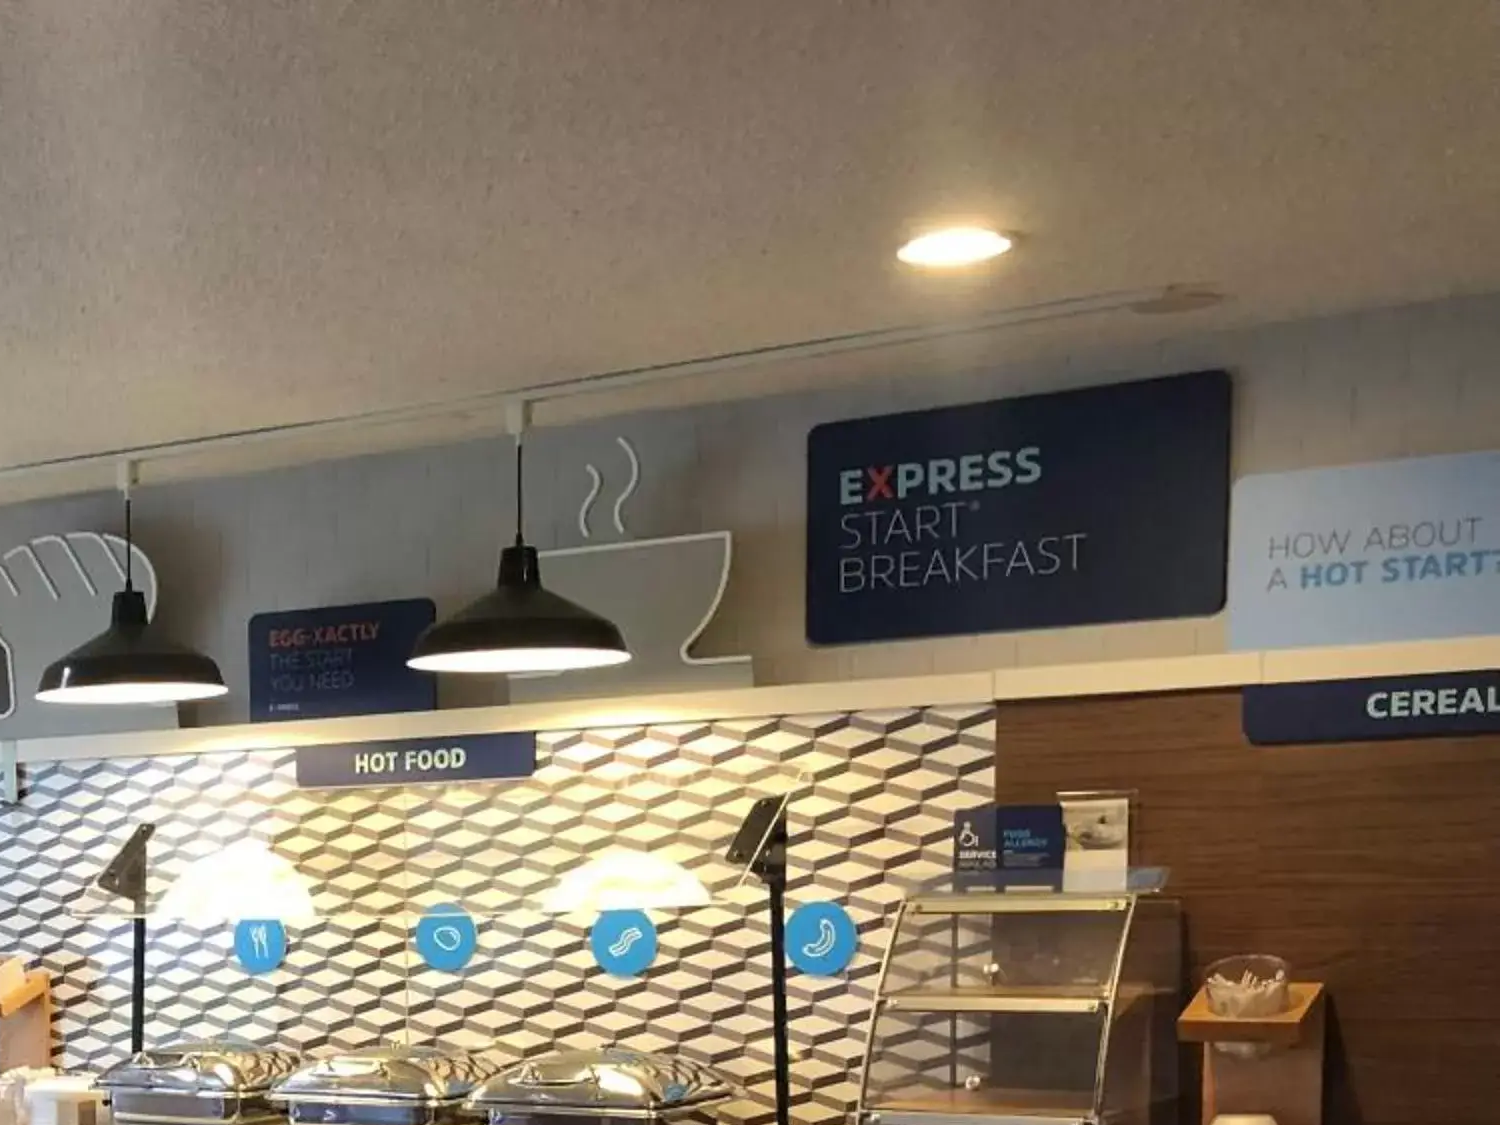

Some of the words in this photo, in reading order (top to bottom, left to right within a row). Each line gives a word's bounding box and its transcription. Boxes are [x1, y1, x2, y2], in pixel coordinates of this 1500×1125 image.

[839, 447, 1042, 504] EXPRESS
[1268, 529, 1352, 559] HOW
[1363, 516, 1483, 551] ABOUT
[839, 533, 1088, 593] BREAKFAST
[1266, 567, 1288, 593] A
[1300, 560, 1369, 589] HOT
[268, 621, 380, 648] EGG-XACTLY
[270, 652, 300, 671] THE
[270, 672, 304, 692] YOU
[309, 670, 355, 691] NEED
[1366, 685, 1500, 719] CEREAL
[354, 751, 398, 774] HOT
[405, 747, 467, 771] FOOD
